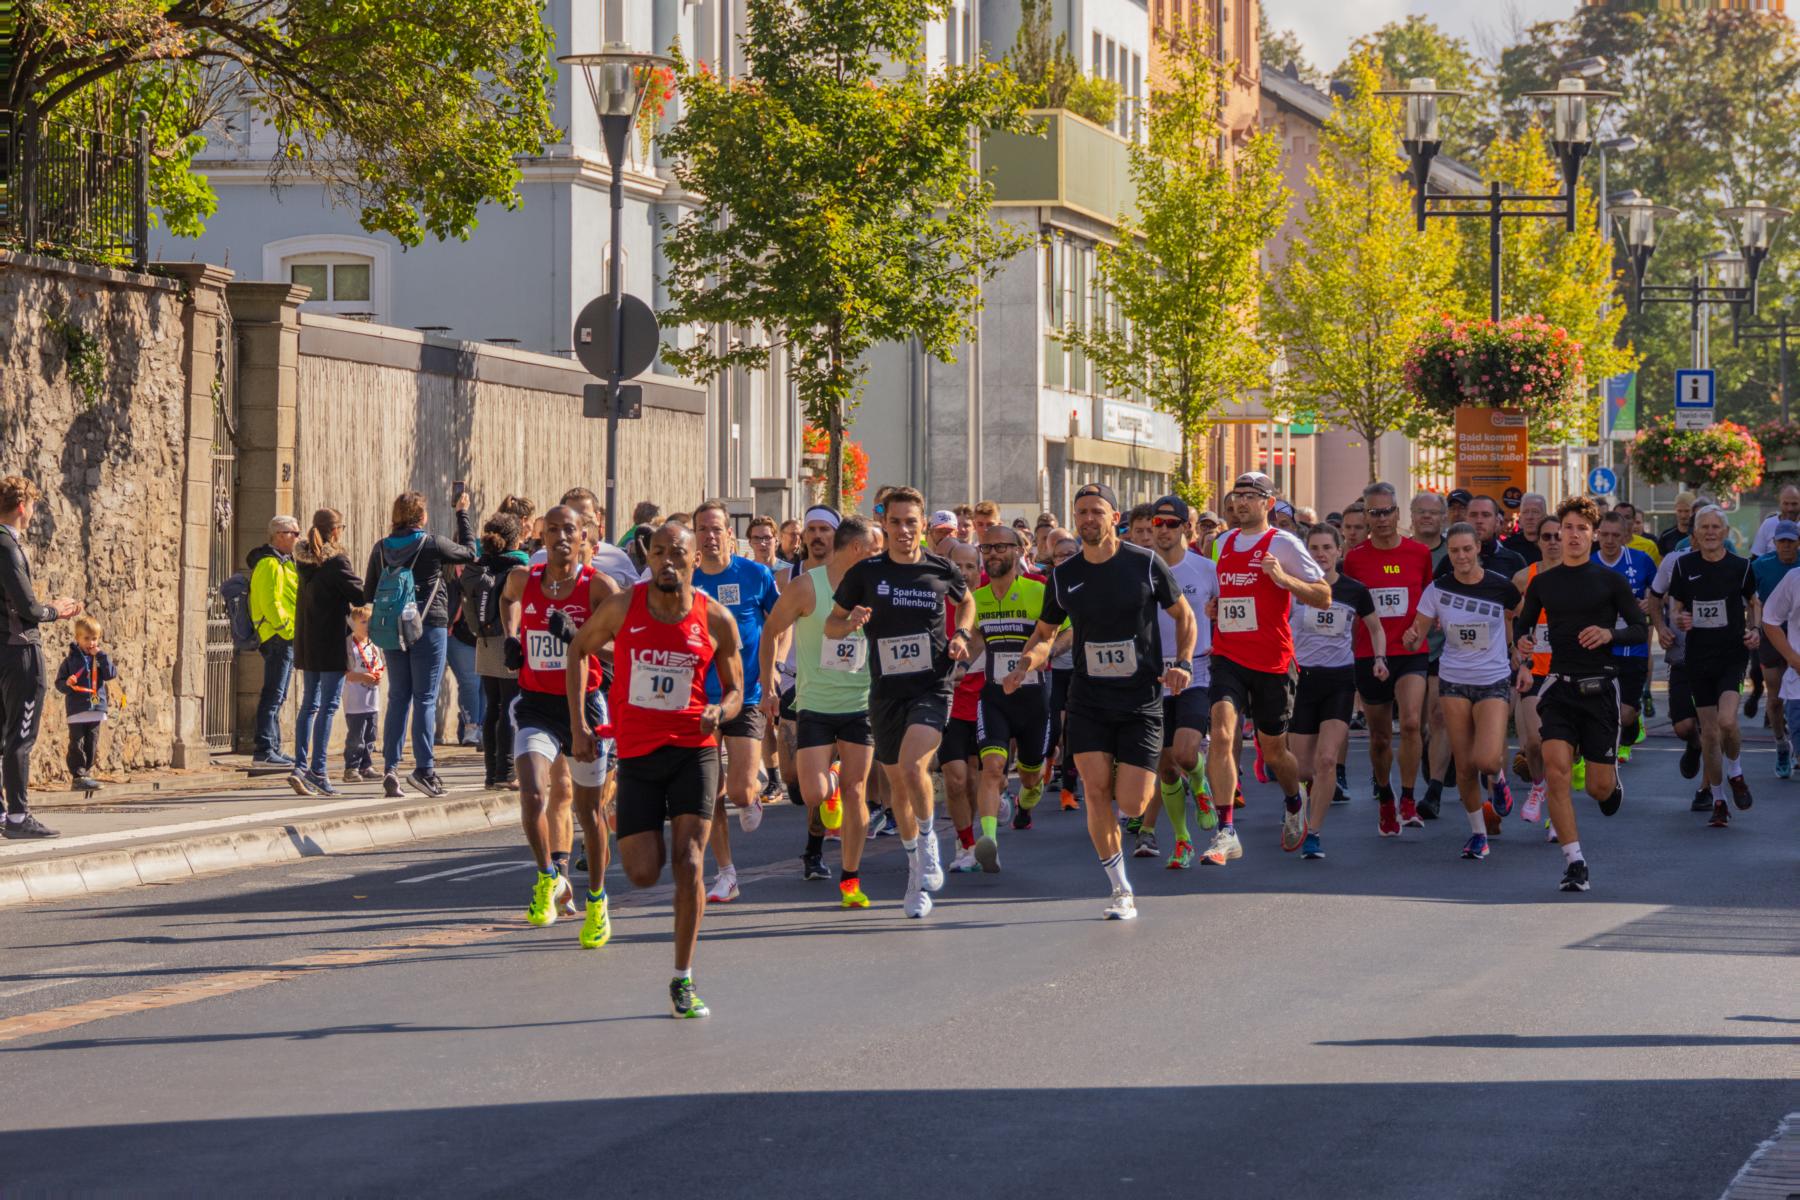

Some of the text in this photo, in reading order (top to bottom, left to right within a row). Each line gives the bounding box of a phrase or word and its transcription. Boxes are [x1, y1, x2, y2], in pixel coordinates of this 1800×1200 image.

[1459, 433, 1518, 442] Bald kommt
[1459, 443, 1516, 452] Glasfaser in
[1459, 452, 1524, 462] Deine Straße!
[1384, 565, 1400, 574] VLG
[1220, 572, 1236, 585] CM
[893, 587, 937, 599] Sparkasse
[480, 591, 488, 621] MAMMUT
[892, 598, 937, 609] Dillenburg
[1378, 594, 1401, 606] 155
[1224, 605, 1246, 619] 193
[1317, 612, 1334, 624] 58
[1698, 607, 1719, 618] 122
[984, 623, 1024, 633] Wuppertal
[1460, 629, 1477, 641] 59
[530, 635, 568, 657] 1730
[836, 643, 855, 658] 82
[891, 643, 920, 659] 129
[630, 648, 669, 666] LCM
[1096, 650, 1125, 664] 113
[651, 675, 674, 694] 10
